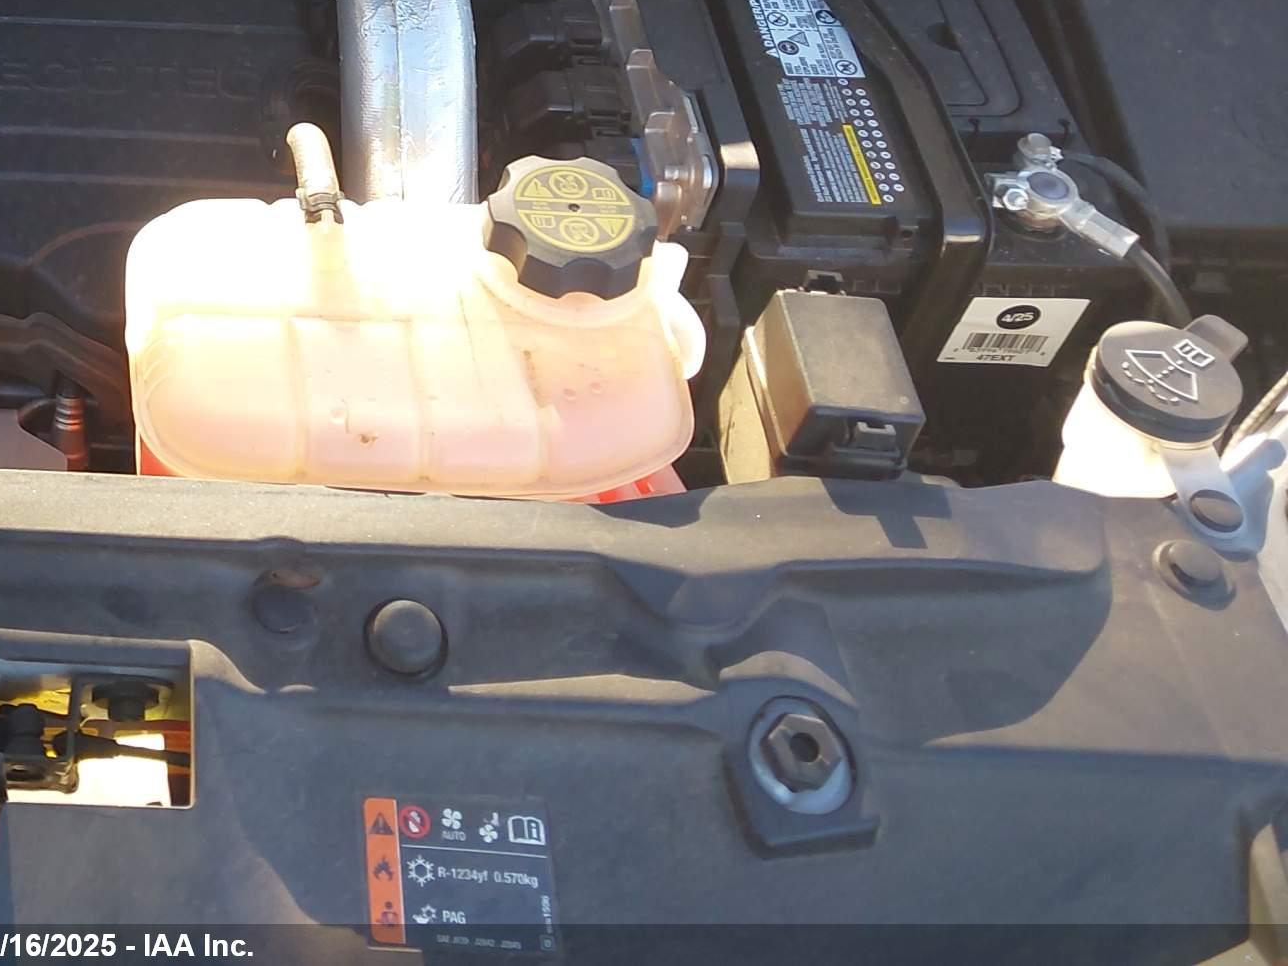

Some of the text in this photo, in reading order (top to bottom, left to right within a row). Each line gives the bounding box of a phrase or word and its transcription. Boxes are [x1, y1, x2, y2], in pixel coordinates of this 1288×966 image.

[1000, 312, 1035, 323] 4/25
[975, 353, 1017, 362] 47EXT
[441, 830, 467, 842] AUTO
[437, 867, 539, 889] R-1234yf 0.570kg
[442, 909, 467, 925] PAG
